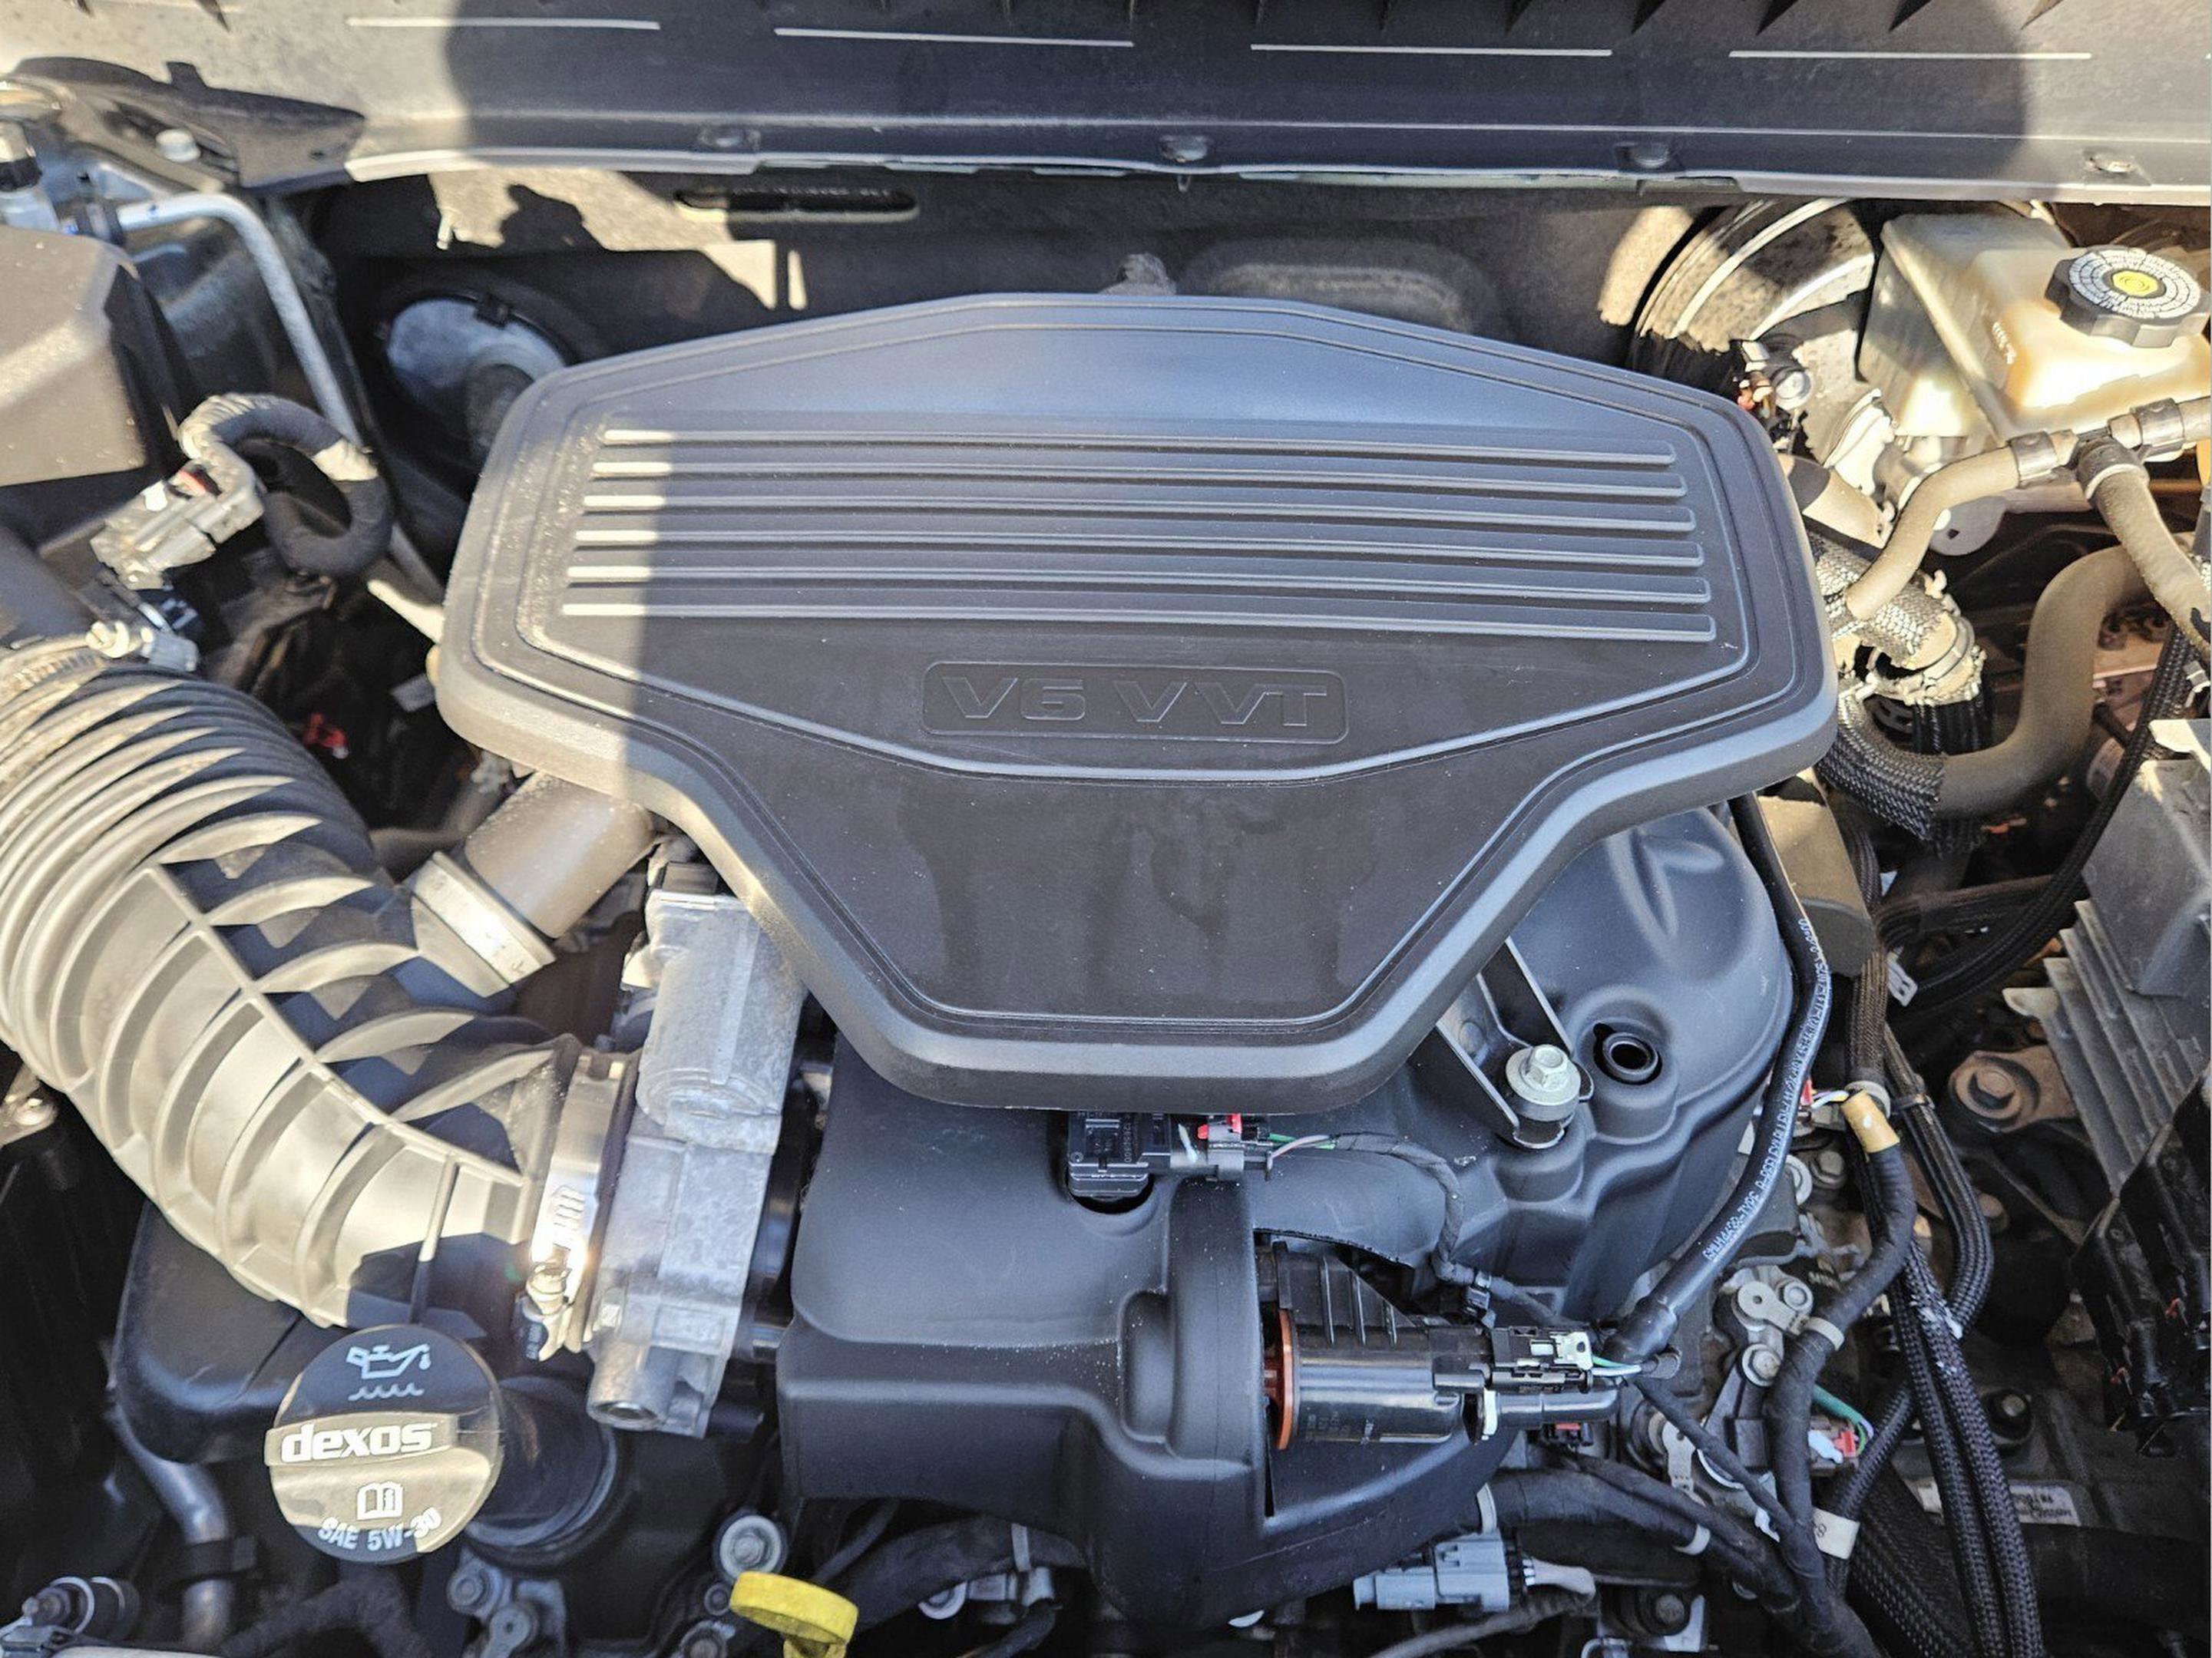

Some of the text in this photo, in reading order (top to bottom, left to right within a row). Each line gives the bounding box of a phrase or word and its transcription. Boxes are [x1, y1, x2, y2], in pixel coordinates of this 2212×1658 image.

[942, 676, 1328, 727] V6 VVT
[281, 1423, 434, 1462] dexos
[318, 1508, 442, 1551] SAE 5W-30
